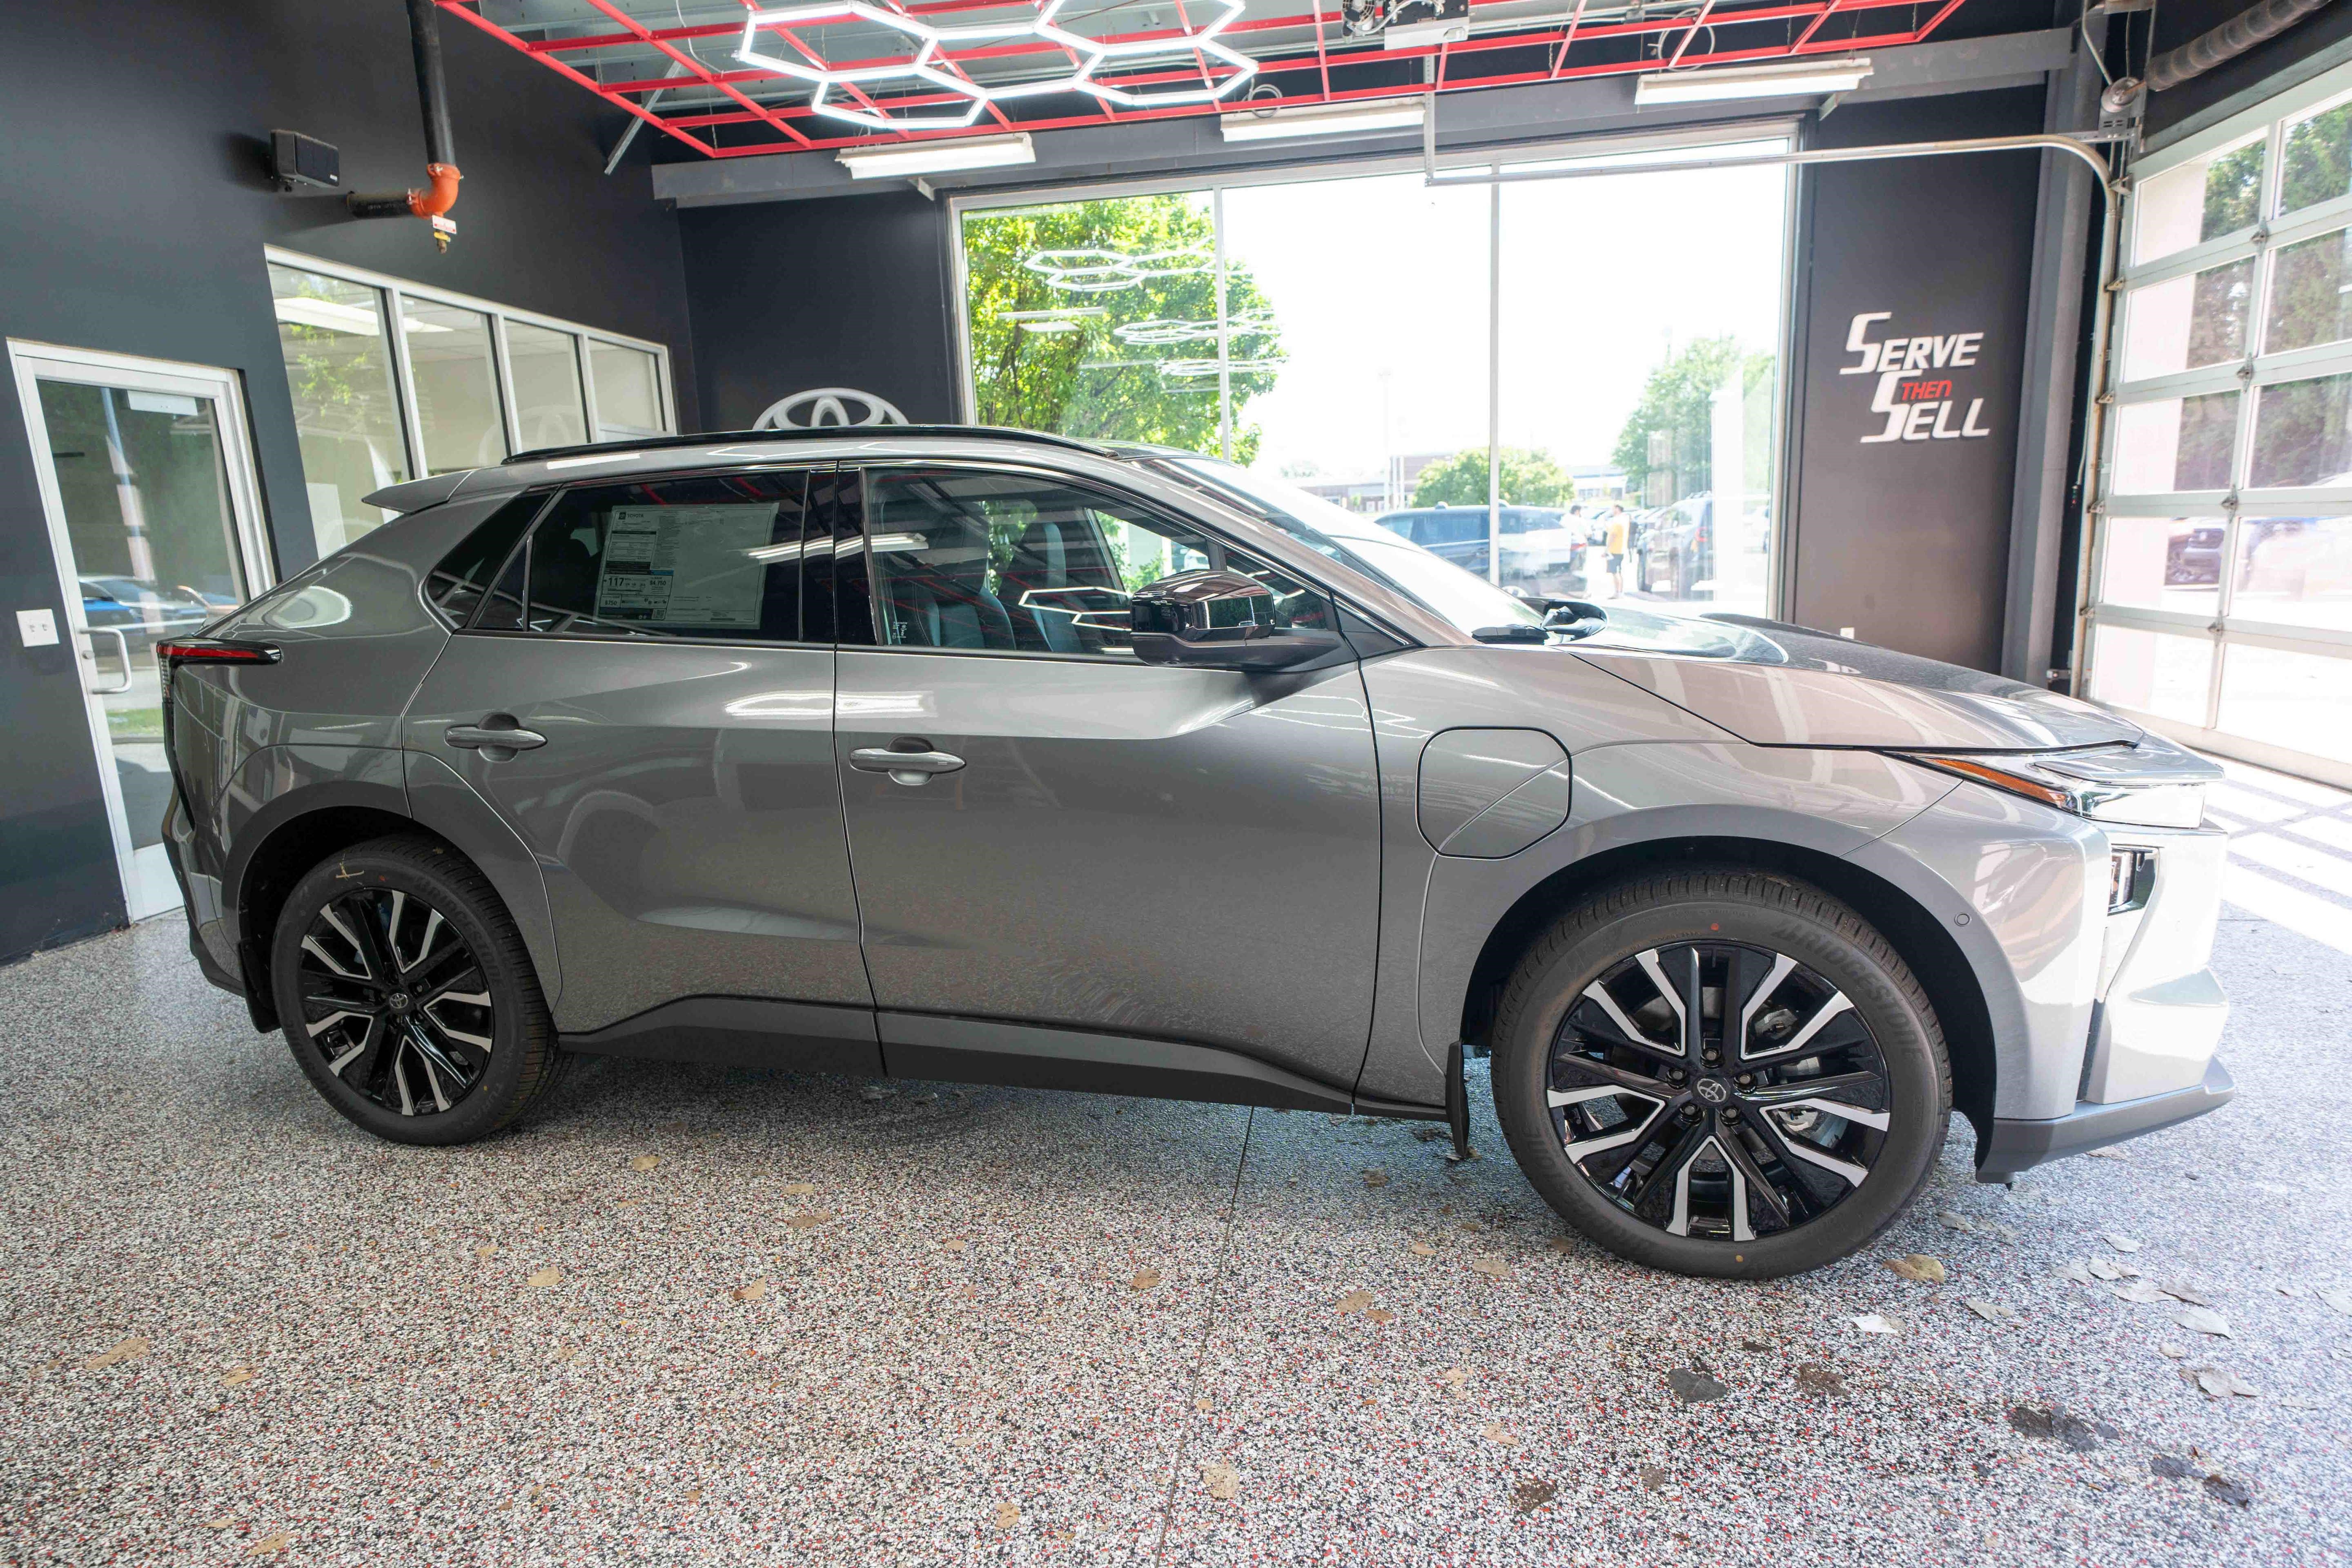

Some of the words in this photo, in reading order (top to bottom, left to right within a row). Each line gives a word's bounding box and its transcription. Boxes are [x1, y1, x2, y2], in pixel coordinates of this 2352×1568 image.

[1839, 312, 1984, 374] SERVE
[1860, 369, 1990, 443] SELL
[1901, 379, 1953, 401] THEN
[608, 577, 624, 586] 117
[1771, 920, 1925, 1058] BRIDGESTONE
